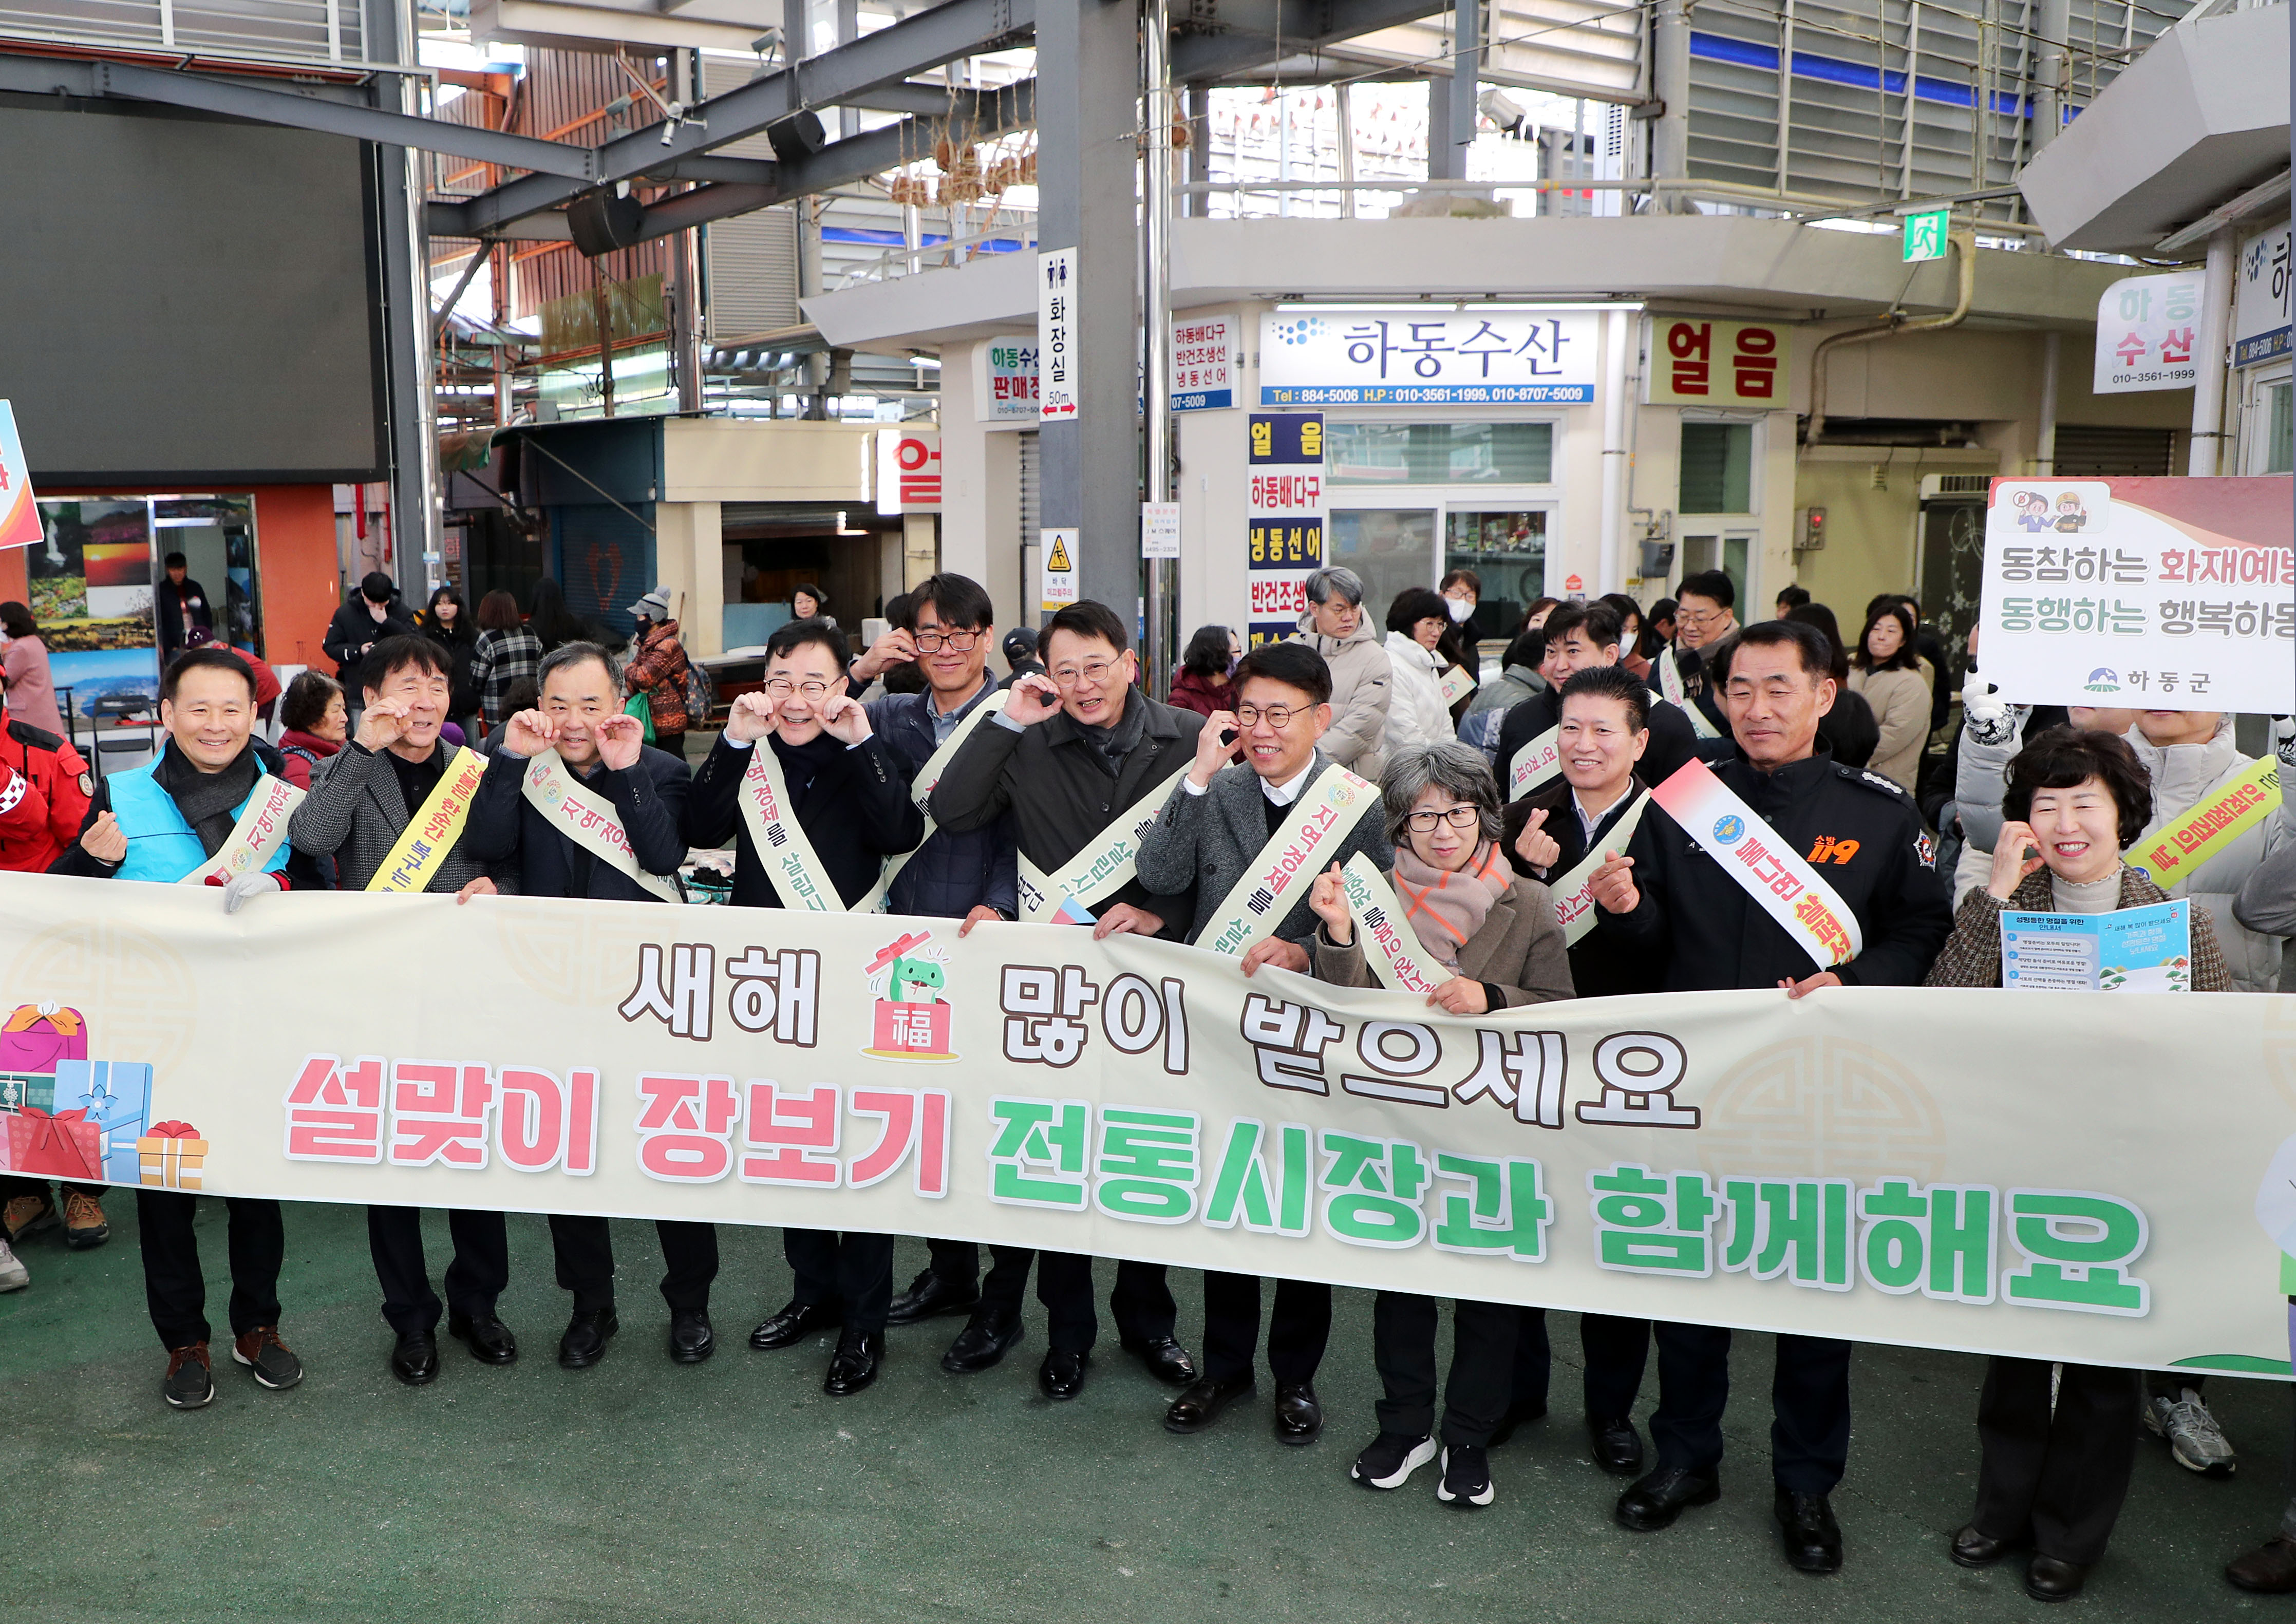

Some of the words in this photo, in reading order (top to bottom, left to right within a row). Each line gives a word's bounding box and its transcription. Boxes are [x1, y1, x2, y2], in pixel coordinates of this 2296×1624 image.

[2119, 285, 2195, 322] 하동
[1051, 296, 1066, 382] 화장실
[1176, 324, 1226, 344] 하동배다구
[1344, 319, 1570, 379] 하동수산
[2116, 327, 2195, 366] 수산
[1177, 346, 1226, 366] 반건조생선
[1668, 322, 1777, 399] 얼음
[1177, 367, 1227, 388] 냉동선어
[2113, 369, 2195, 384] 010-3561-1999
[1049, 390, 1069, 404] 50m
[1302, 389, 1359, 403] 884-5006
[1396, 388, 1490, 403] 010-3561-1999,
[1492, 387, 1584, 401] 010-8707-5009
[1251, 421, 1322, 456] 얼음
[1252, 476, 1320, 509] 하동배다구
[1250, 527, 1321, 562] 냉동선어
[2001, 546, 2148, 582] 동참하는
[2001, 597, 2146, 633] 동행하는
[2128, 670, 2211, 694] 하동군
[1516, 746, 1557, 783] 역경제
[246, 779, 294, 852] 지역경제
[424, 797, 461, 843] 한순간
[2173, 783, 2267, 855] 안전점검의
[1806, 839, 1860, 865] 119
[1814, 835, 1837, 845] 소방
[391, 839, 432, 889] 복구는
[1247, 803, 1339, 916] 지역경제를
[1735, 837, 1805, 902] 불나면
[2149, 844, 2180, 873] 날
[1362, 907, 1402, 959] 이용을
[618, 943, 821, 1048] 새해
[892, 1009, 932, 1050] 福
[1001, 964, 1189, 1075] 많이
[1240, 992, 1701, 1129] 받으세요
[286, 1055, 598, 1174] 설맞이
[638, 1075, 948, 1195] 장보기
[988, 1098, 1550, 1260] 전통시장과
[1590, 1164, 2144, 1313] 함께해요
